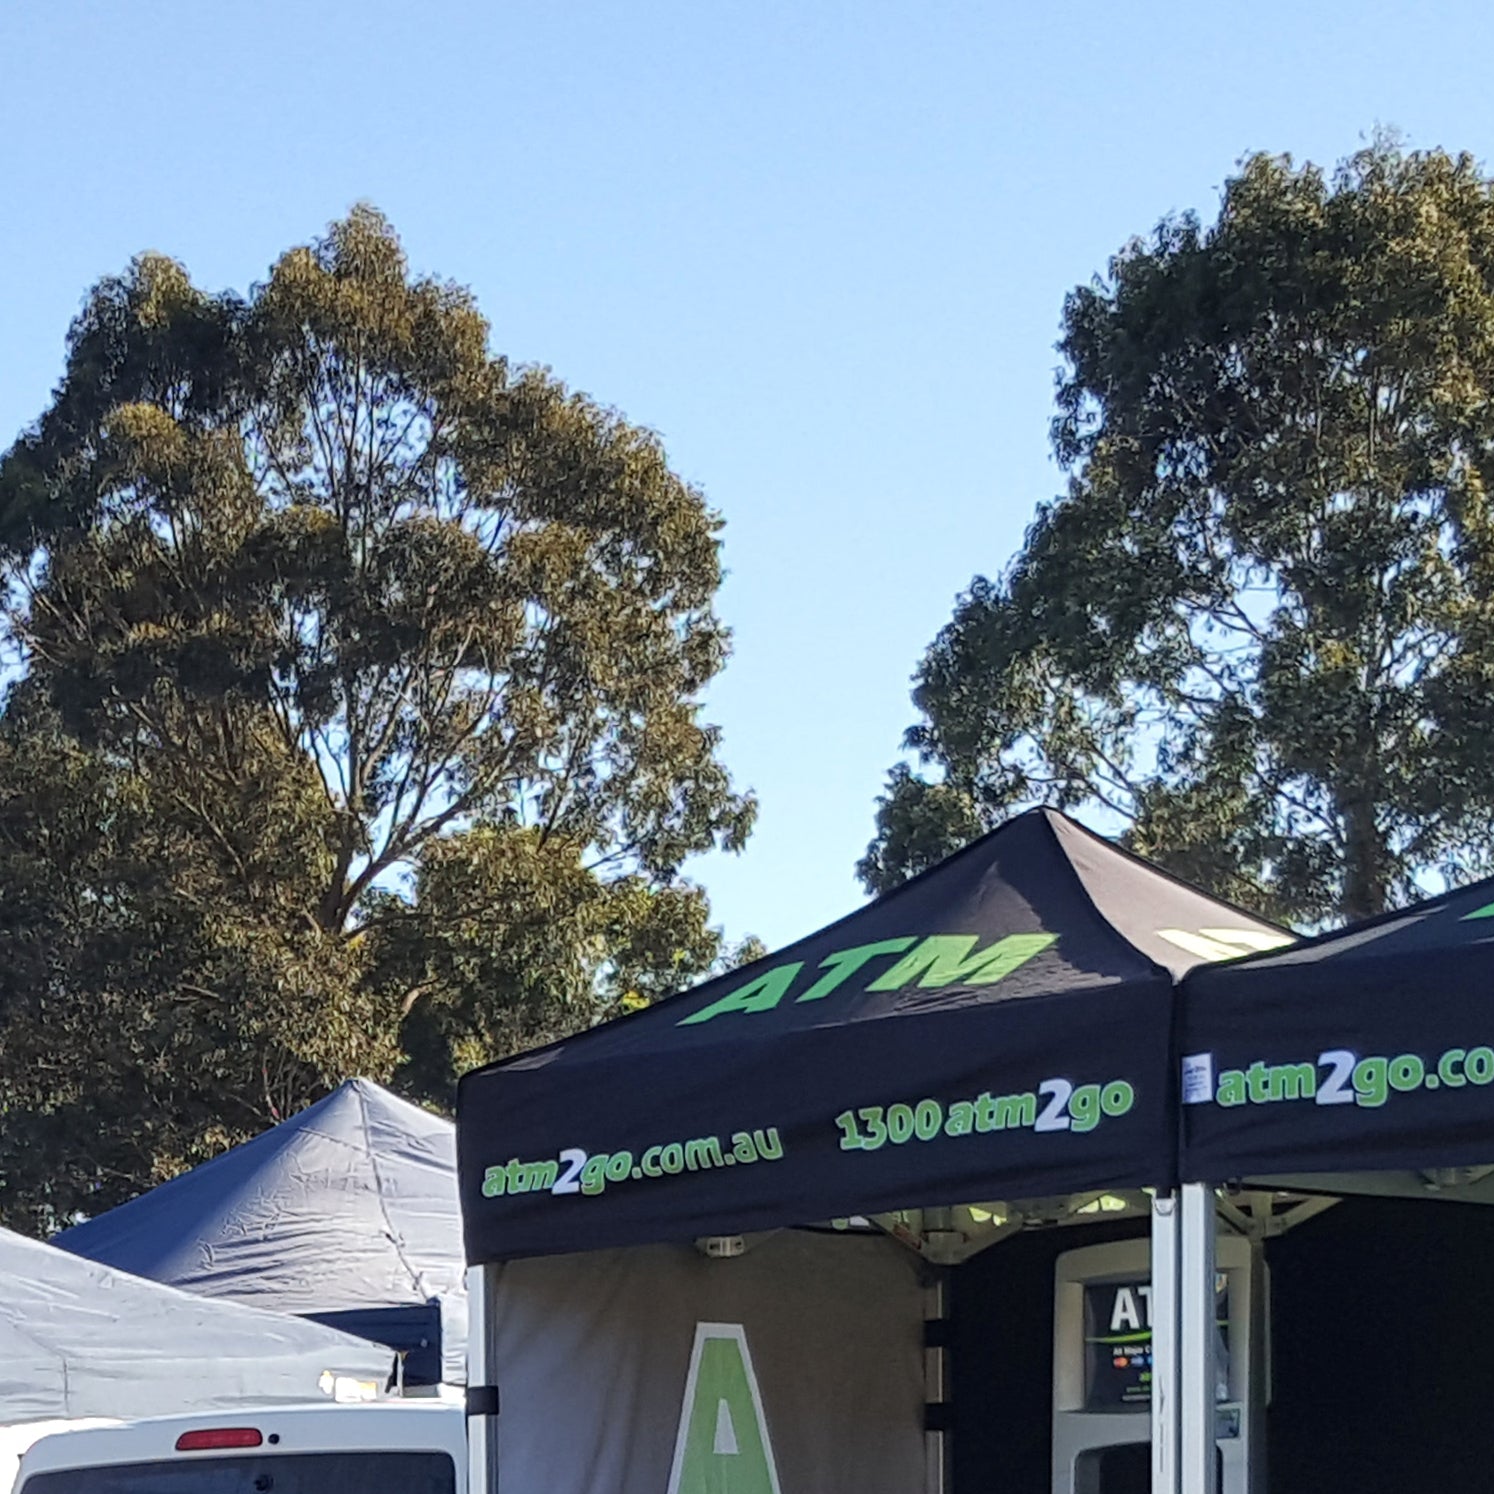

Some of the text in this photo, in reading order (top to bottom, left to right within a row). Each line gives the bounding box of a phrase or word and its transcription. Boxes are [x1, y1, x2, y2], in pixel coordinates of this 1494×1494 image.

[676, 932, 1060, 1026] ATM
[481, 1123, 785, 1198] atm2go.com.au
[1110, 1284, 1153, 1331] AT
